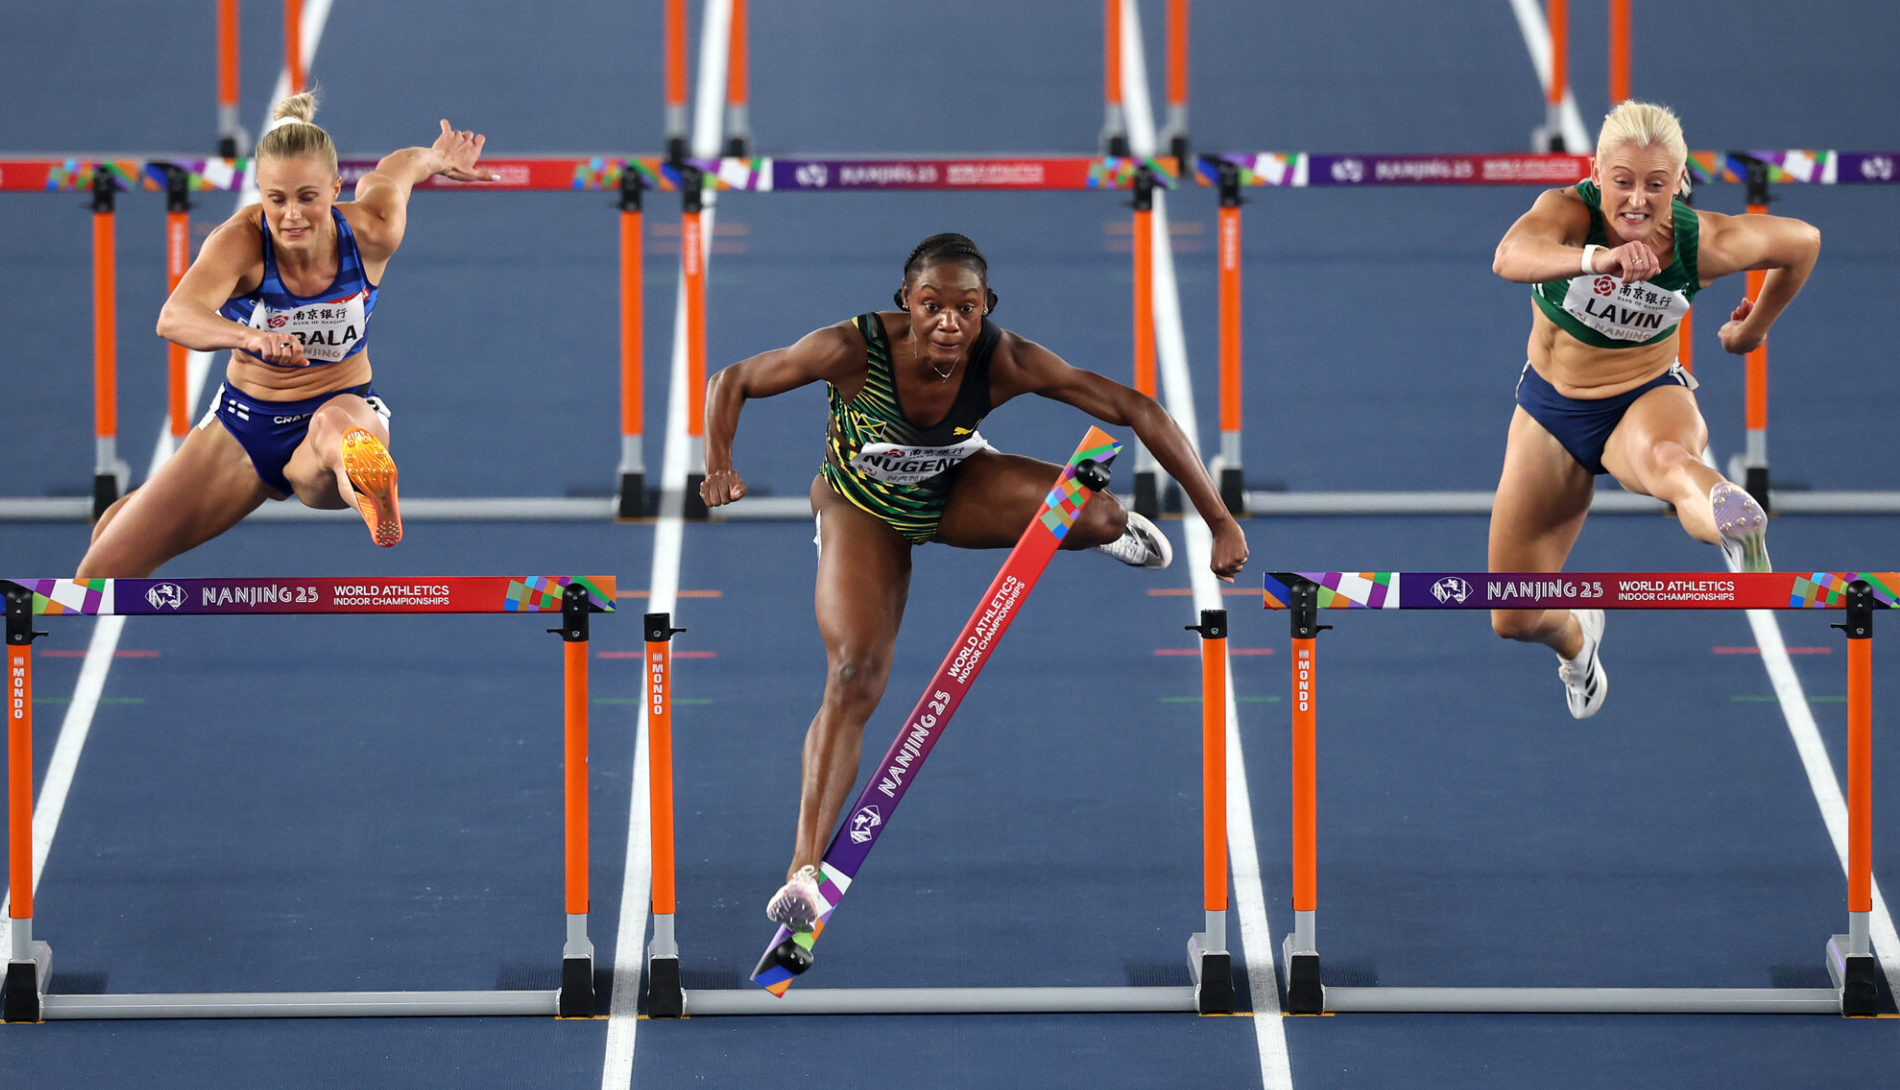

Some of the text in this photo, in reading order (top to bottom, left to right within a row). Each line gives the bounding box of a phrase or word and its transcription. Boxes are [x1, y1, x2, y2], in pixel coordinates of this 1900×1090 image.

[293, 308, 347, 320] 南京银行
[1585, 298, 1663, 329] LAVIN
[202, 584, 319, 607] NANJING 25
[333, 585, 450, 596] WORLD ATHLETICS
[1487, 579, 1604, 602] NANJING 25
[1618, 580, 1735, 591] WORLD ATHLETICS
[1618, 592, 1735, 601] INDOOR CHAMPIONSHIPS
[333, 597, 450, 606] INDOOR CHAMPIONSHIPS
[947, 575, 1017, 677] WORLD ATHLETICS
[957, 581, 1025, 684] INDOOR CHAMPIONSHIPS
[12, 667, 25, 719] MONDO
[652, 663, 664, 715] MONDO
[1298, 660, 1310, 712] MONDO
[877, 690, 951, 798] NANJING 25
